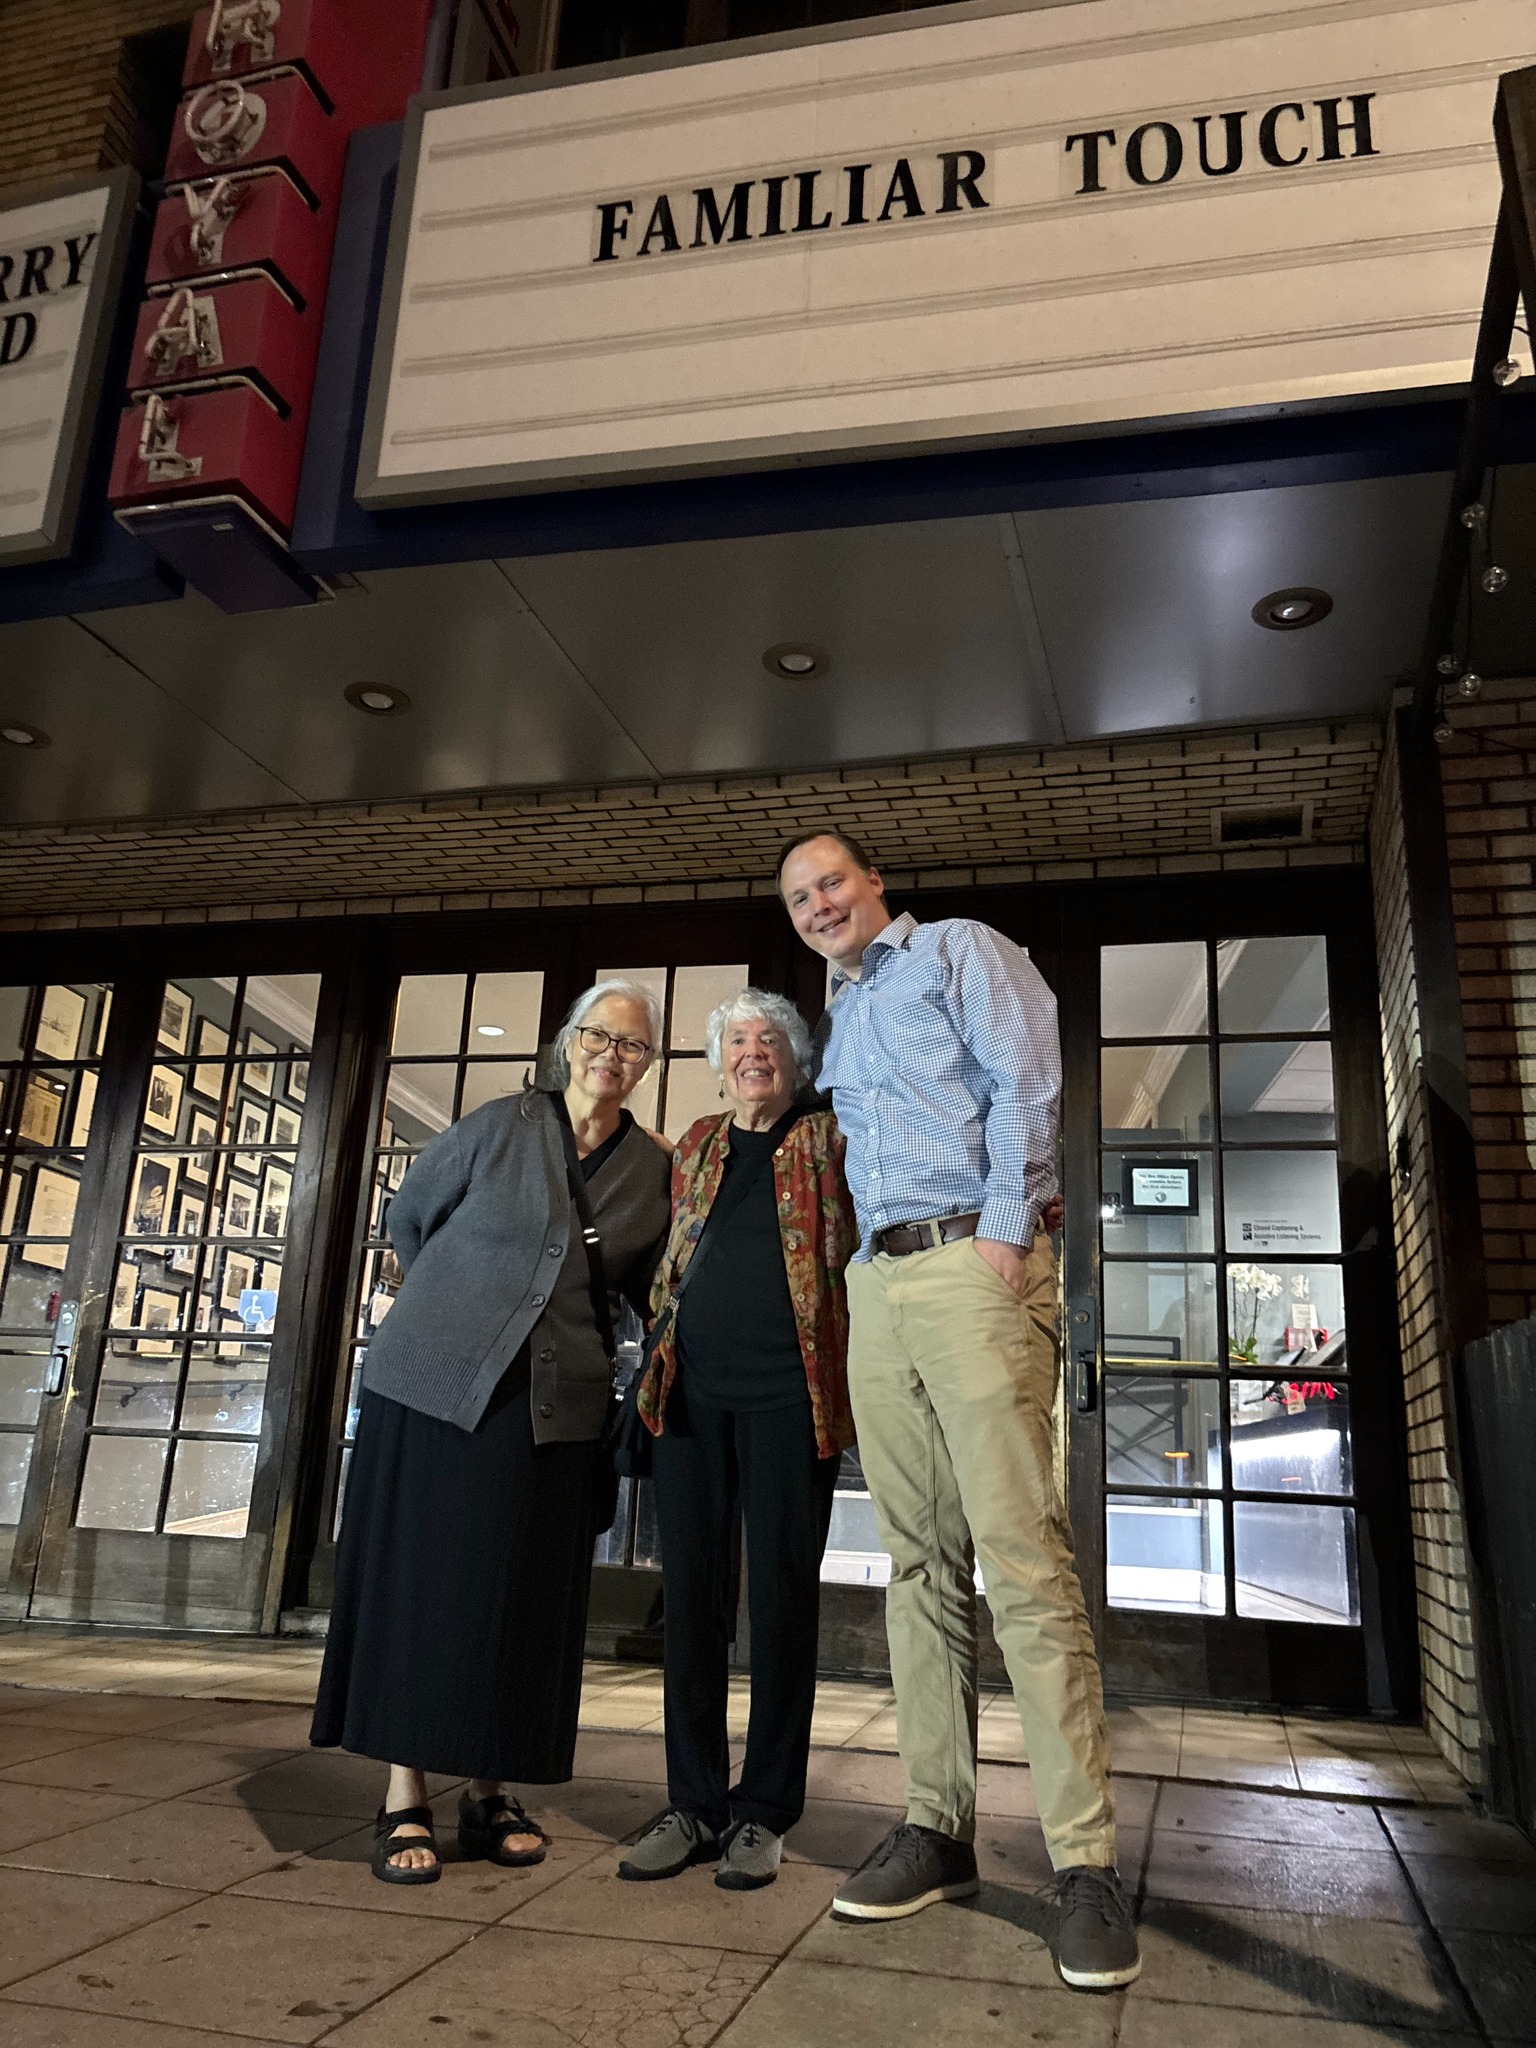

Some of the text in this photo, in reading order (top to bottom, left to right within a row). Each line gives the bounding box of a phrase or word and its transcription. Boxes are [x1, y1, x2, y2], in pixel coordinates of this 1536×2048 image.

[592, 92, 1380, 262] FAMILIAR TOUCH
[1272, 1224, 1298, 1232] Captioning
